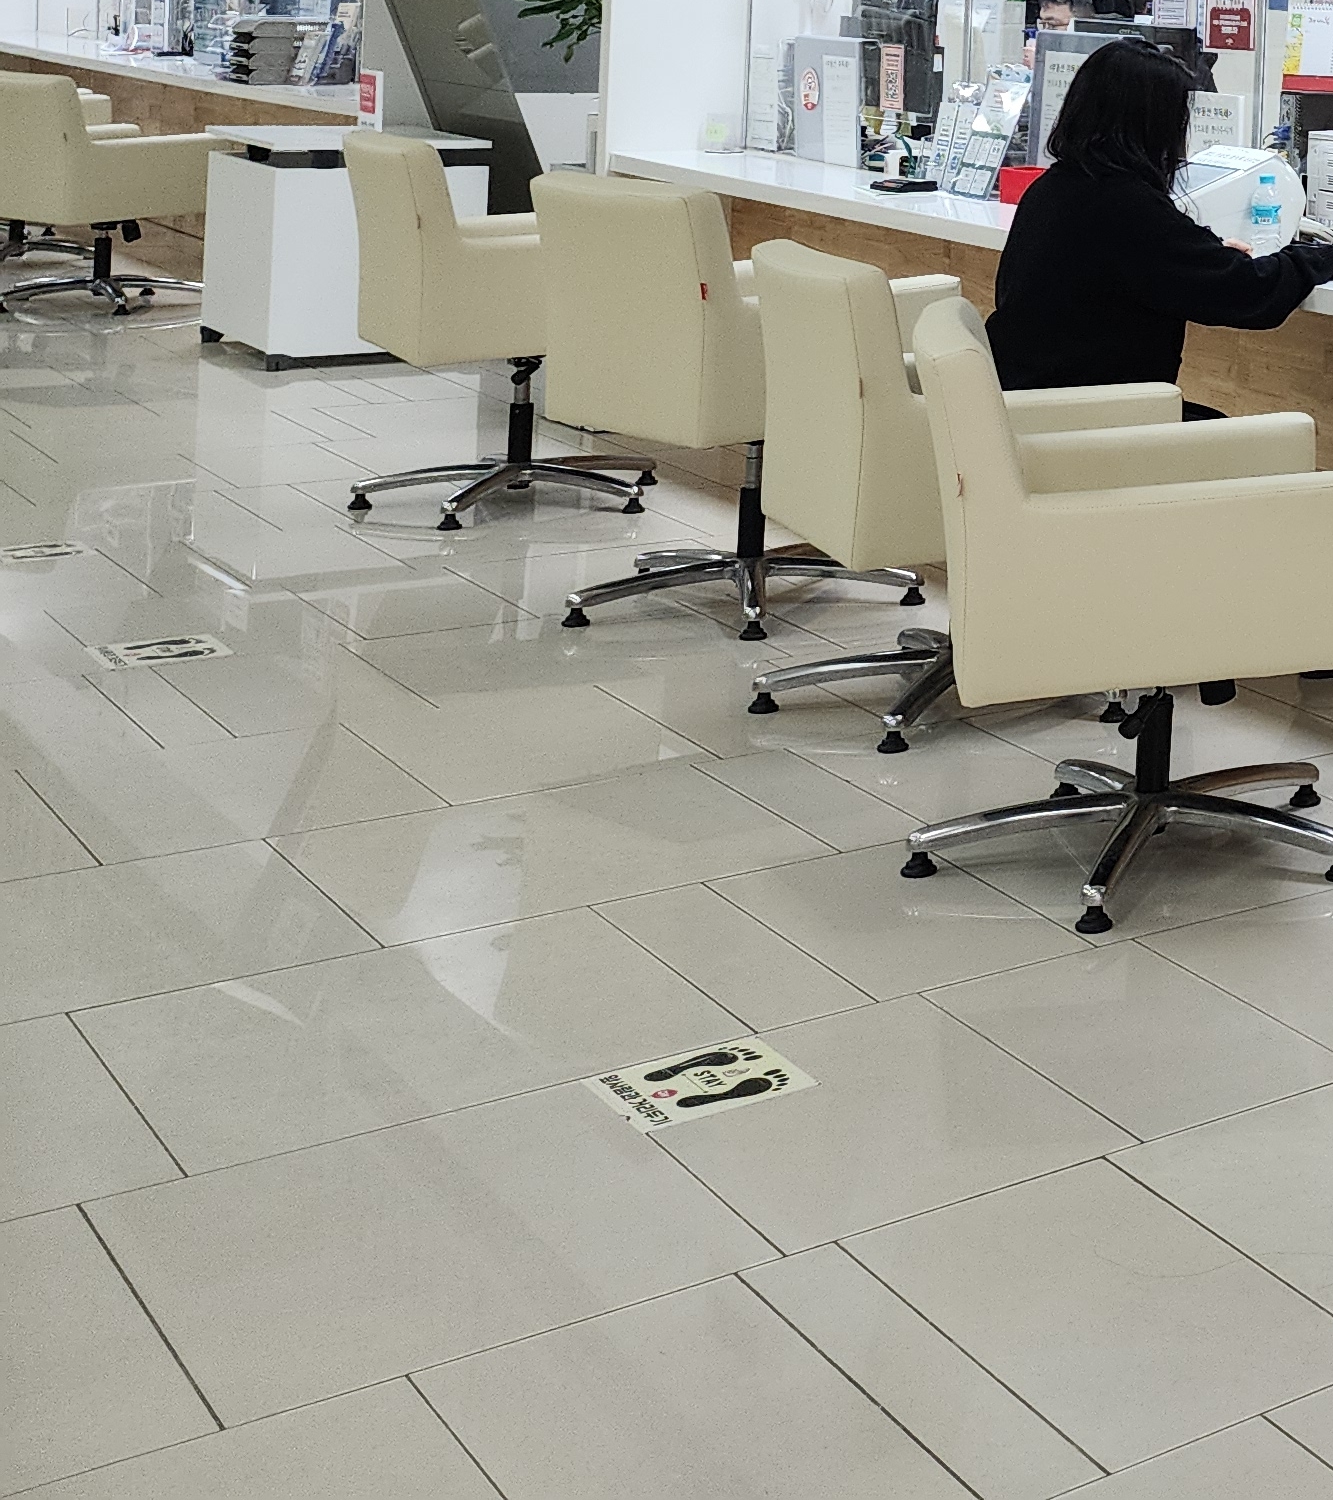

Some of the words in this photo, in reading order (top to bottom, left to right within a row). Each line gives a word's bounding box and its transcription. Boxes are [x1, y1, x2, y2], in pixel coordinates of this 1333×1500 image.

[693, 1070, 728, 1088] STAY
[599, 1073, 643, 1105] 앞사람과
[629, 1095, 673, 1127] 거리두기
